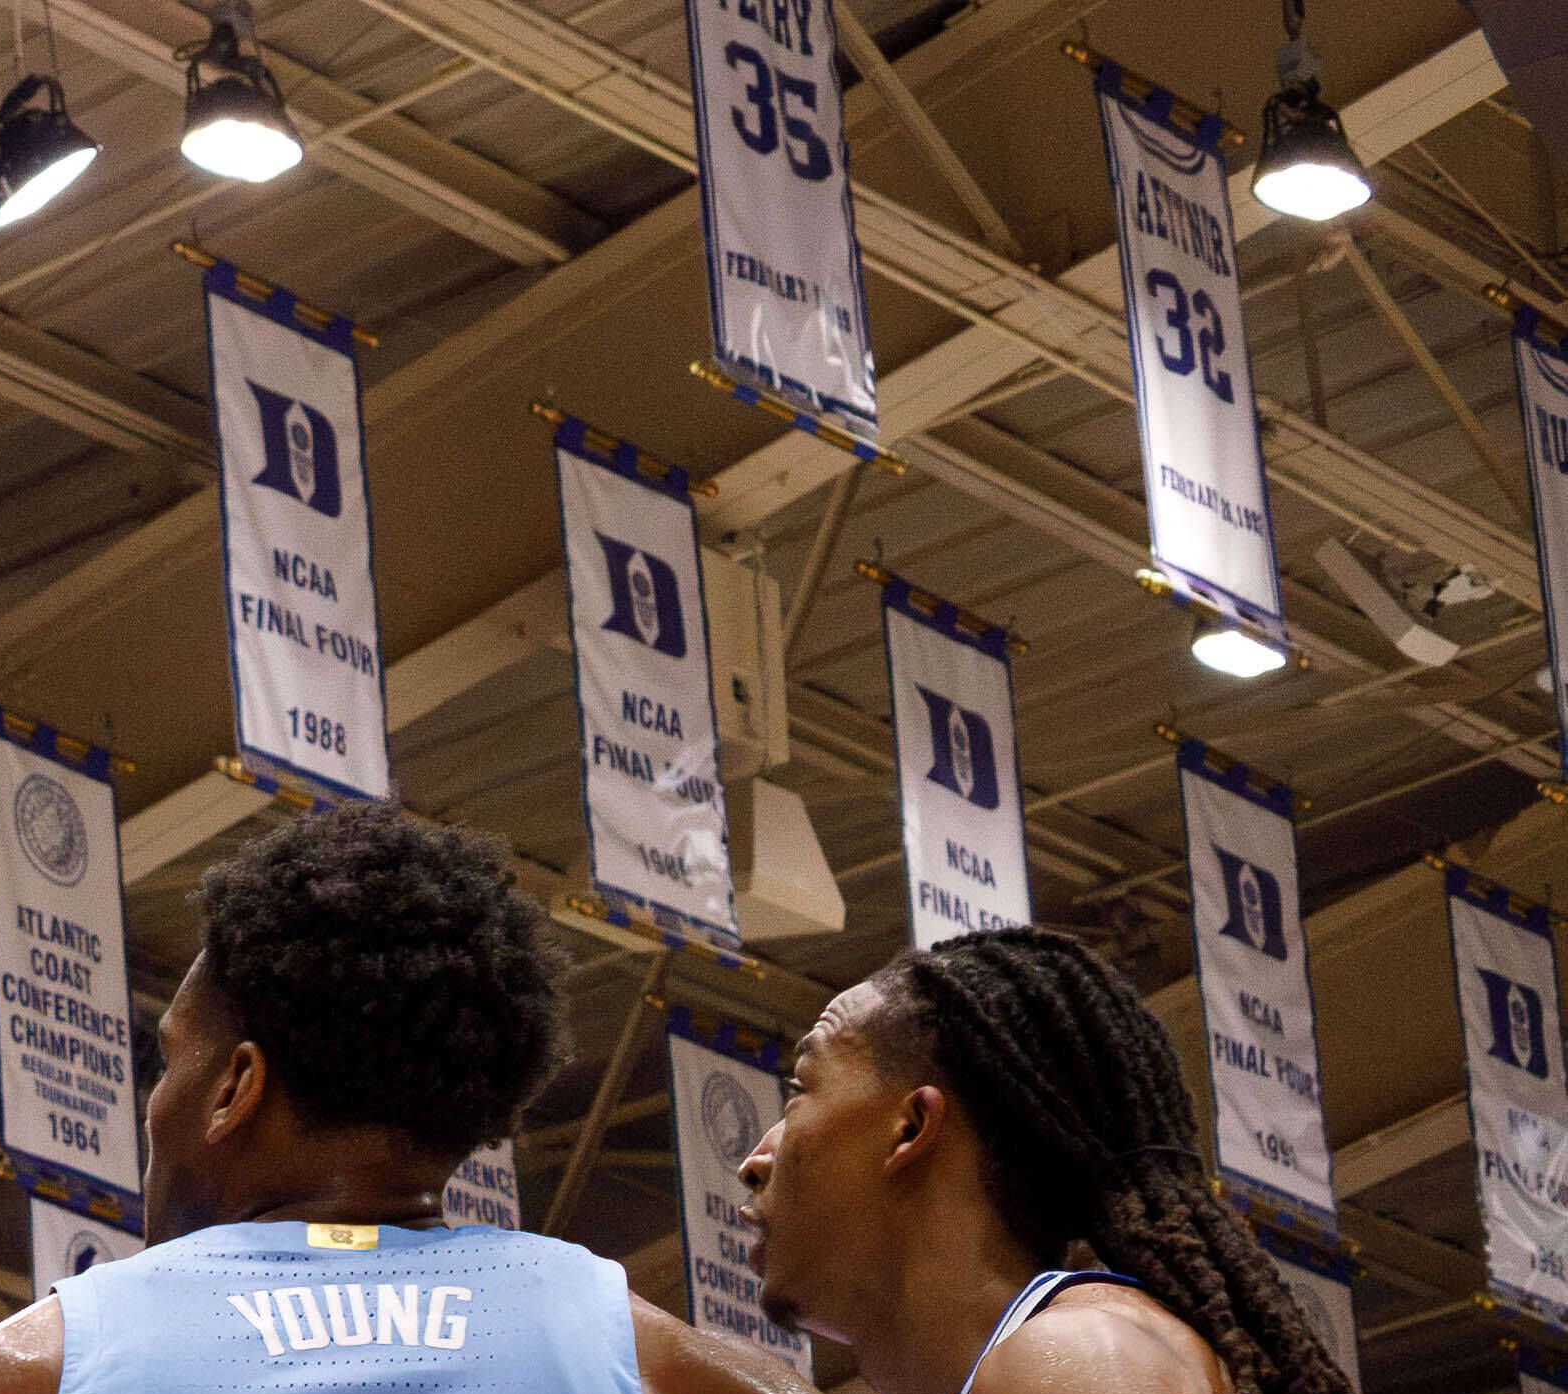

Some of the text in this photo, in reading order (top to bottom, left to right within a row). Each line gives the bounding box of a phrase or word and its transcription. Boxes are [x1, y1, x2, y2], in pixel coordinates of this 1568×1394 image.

[725, 41, 832, 182] 35
[1148, 268, 1234, 404] 32
[273, 548, 337, 601] NCAA
[240, 594, 375, 677] FINAL FOUR
[287, 707, 347, 756] 1988
[622, 690, 683, 740] NCAA
[947, 839, 996, 888] NCAA
[919, 883, 969, 930] FINAL
[17, 903, 103, 964] ATLANTIC
[30, 948, 91, 998] COAST
[2, 972, 126, 1050] CONFERENCE
[1239, 991, 1284, 1035] NCAA
[10, 1013, 124, 1087] CHAMPIONS
[1214, 1033, 1271, 1078] FINAL
[48, 1114, 100, 1159] 1964
[447, 1186, 516, 1231] MPIONS
[231, 1284, 473, 1357] YOUNG
